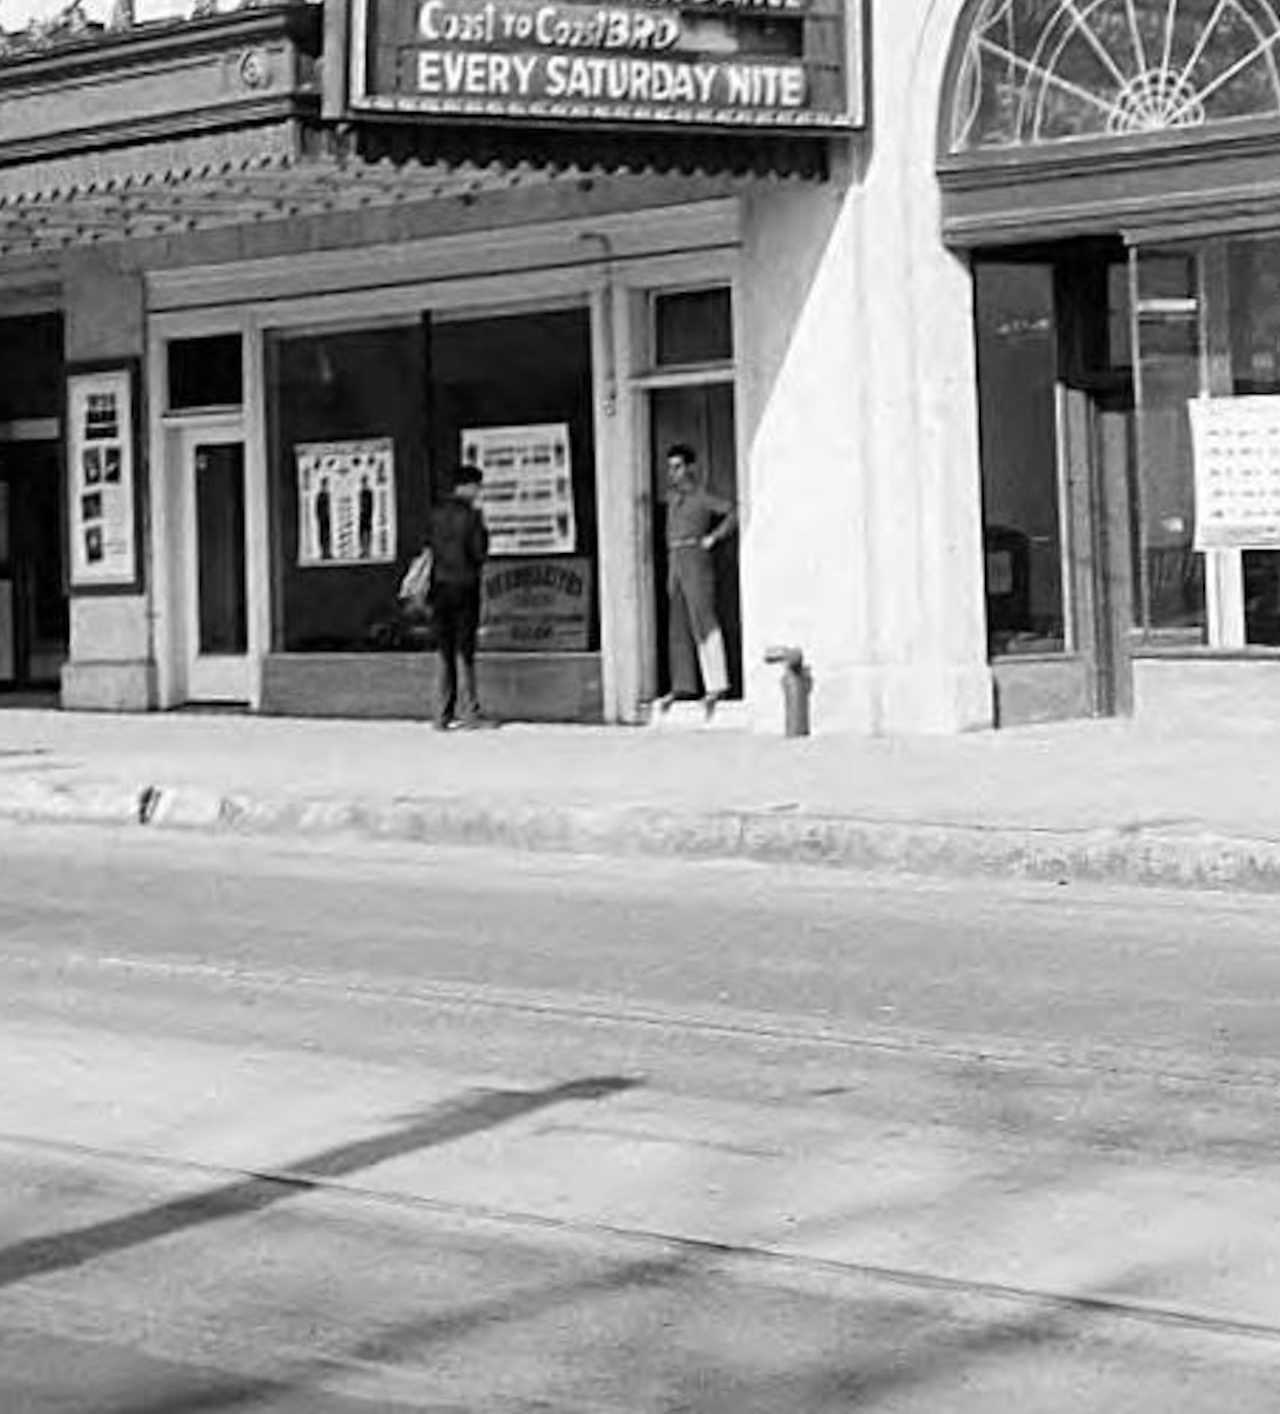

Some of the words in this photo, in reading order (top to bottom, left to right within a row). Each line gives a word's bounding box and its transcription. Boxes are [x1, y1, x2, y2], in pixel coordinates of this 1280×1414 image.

[418, 50, 538, 95] EVERY
[545, 56, 720, 103] SATURDAY
[724, 64, 804, 107] NITE
